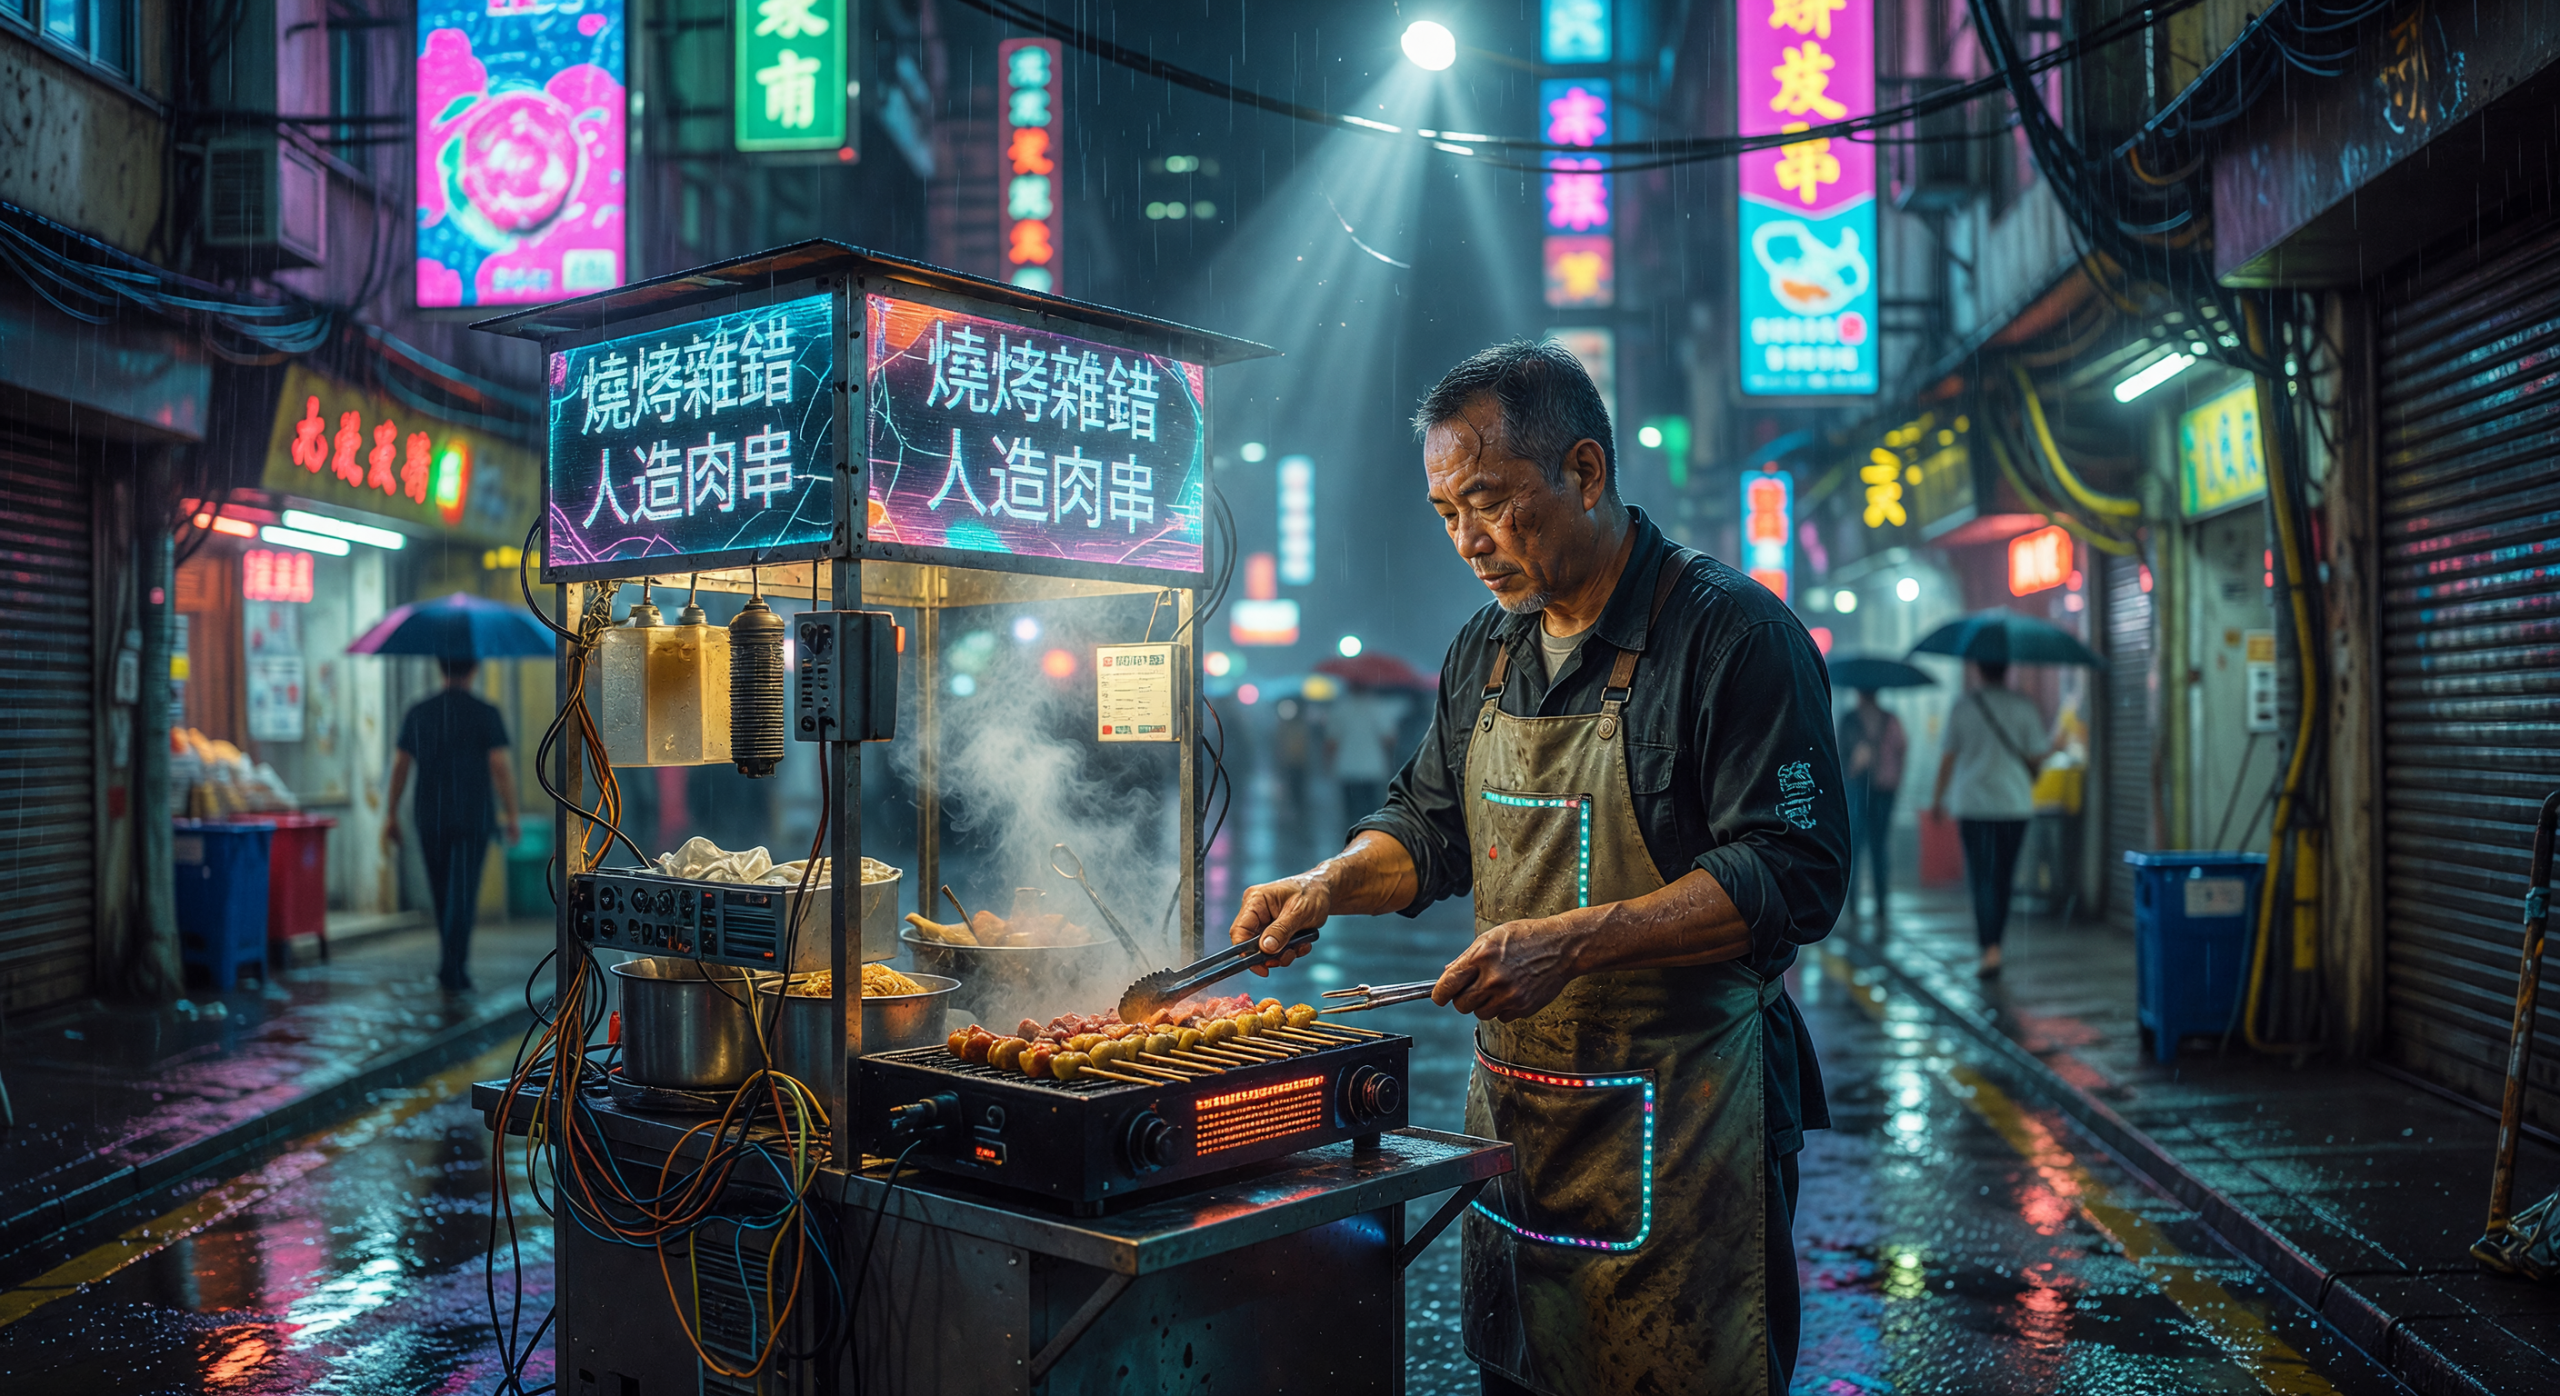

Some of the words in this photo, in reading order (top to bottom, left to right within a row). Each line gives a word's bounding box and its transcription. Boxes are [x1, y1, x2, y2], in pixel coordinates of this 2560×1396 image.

[582, 424, 793, 530] 人造肉串
[927, 428, 1154, 534] 人造肉串
